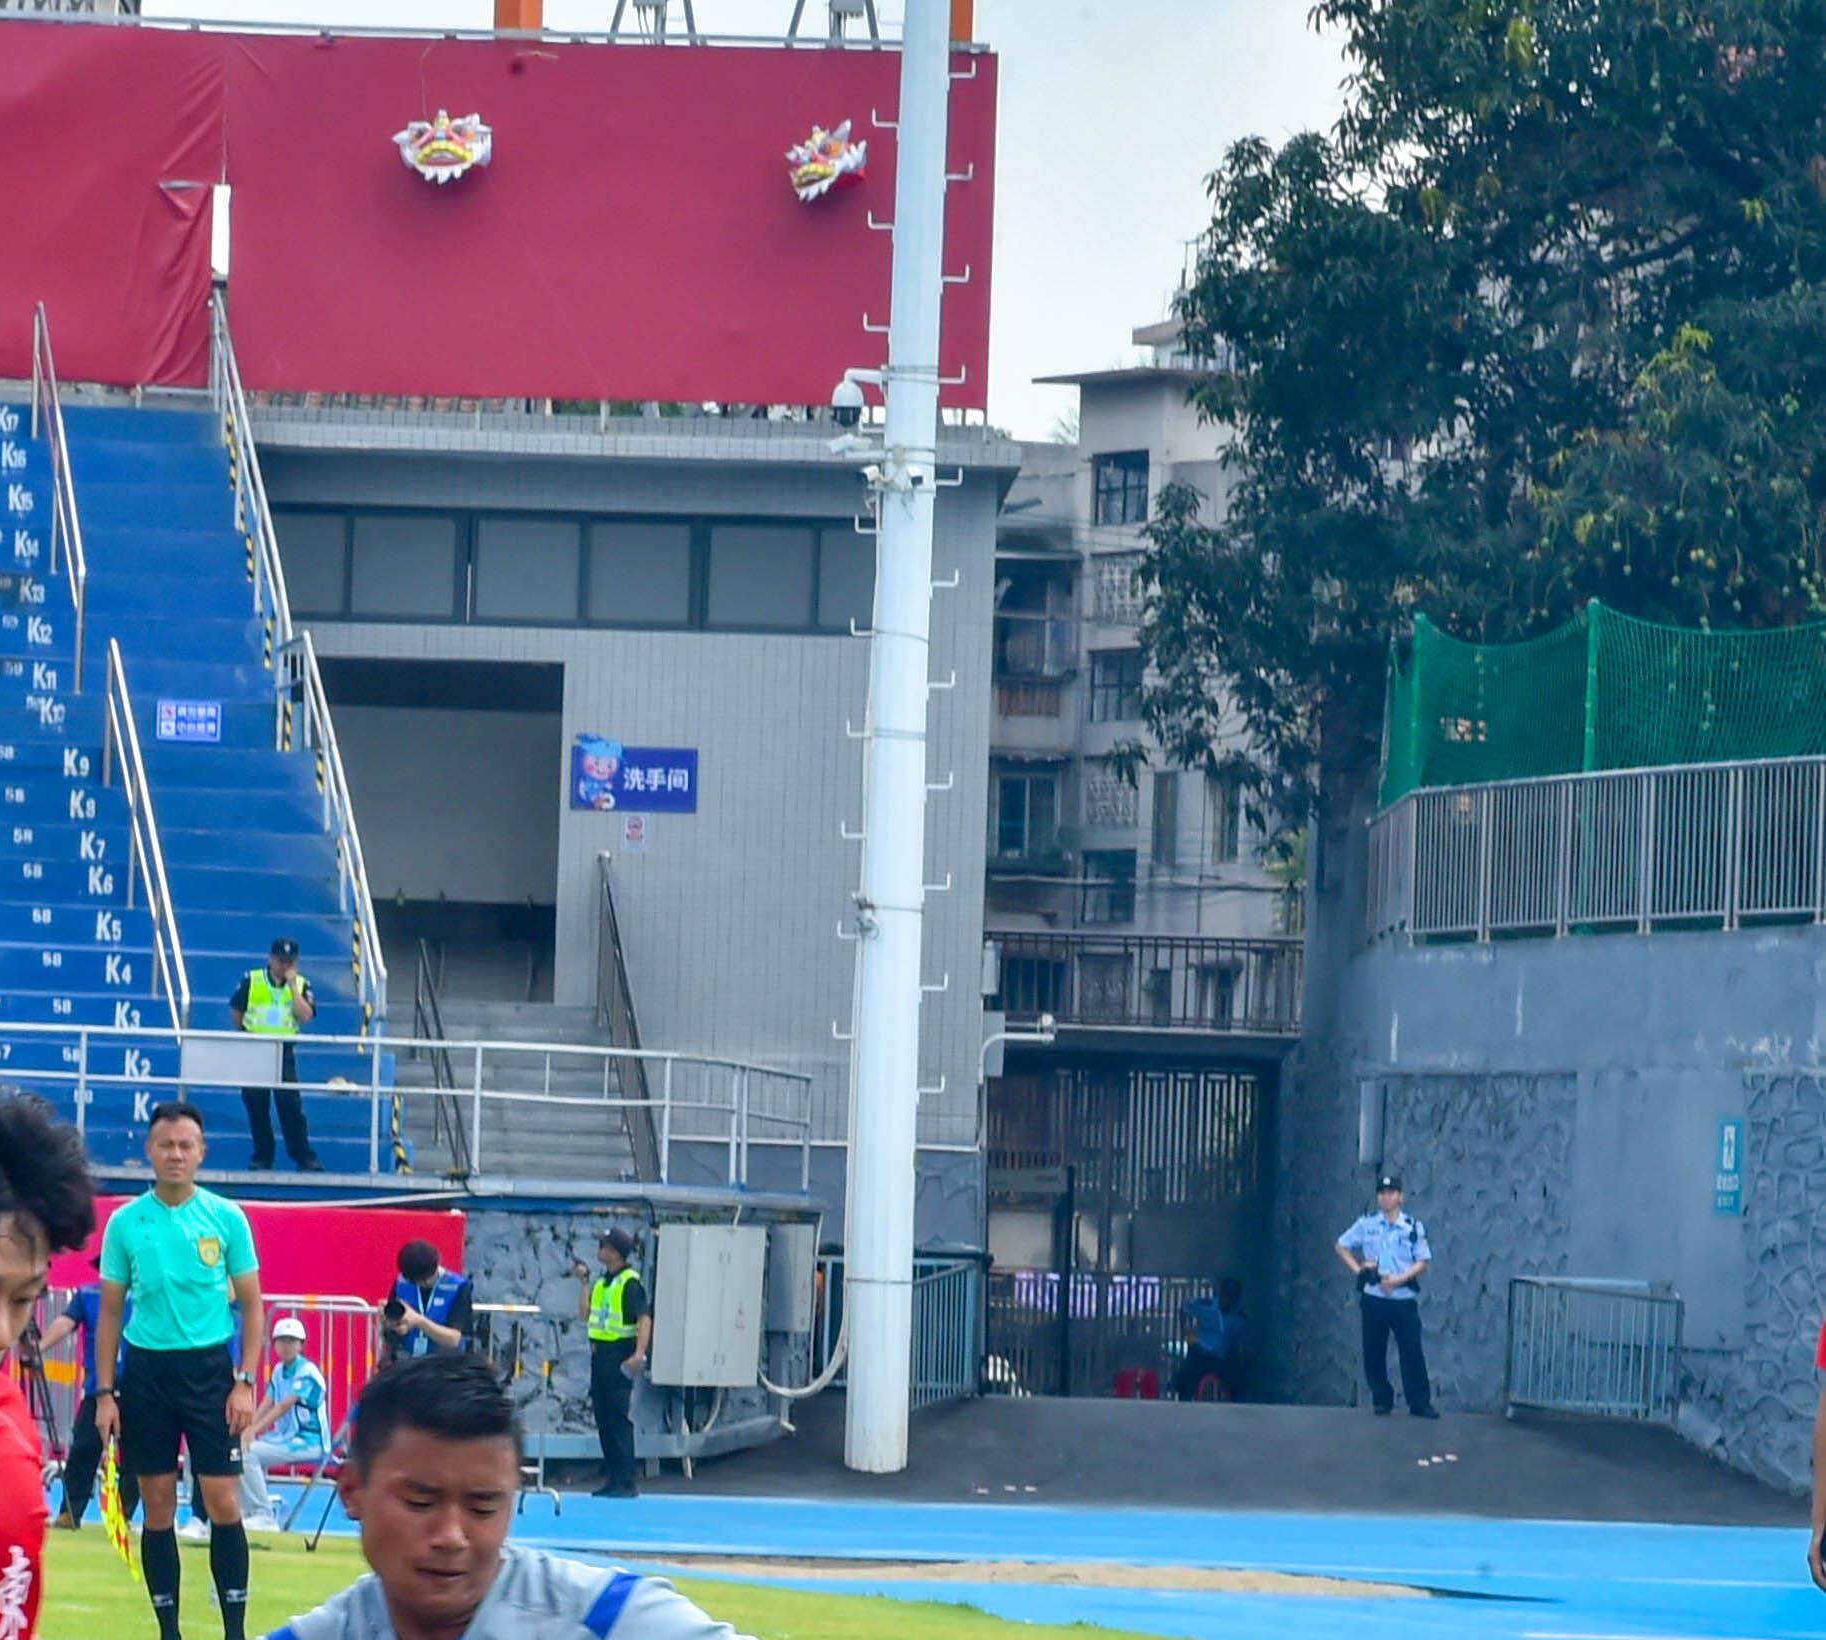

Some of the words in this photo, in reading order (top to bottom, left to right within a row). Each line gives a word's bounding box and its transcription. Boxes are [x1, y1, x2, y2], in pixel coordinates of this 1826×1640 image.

[26, 616, 52, 645] K12
[33, 661, 57, 690] K11
[63, 748, 90, 778] K9
[622, 766, 689, 792] 洗手间
[69, 789, 96, 819] K8
[80, 830, 105, 860] K7
[88, 865, 114, 895] K6
[96, 911, 122, 941] K5
[105, 954, 132, 984] K4
[113, 1001, 140, 1028] K3
[123, 1049, 151, 1078] K2
[134, 1091, 159, 1122] K
